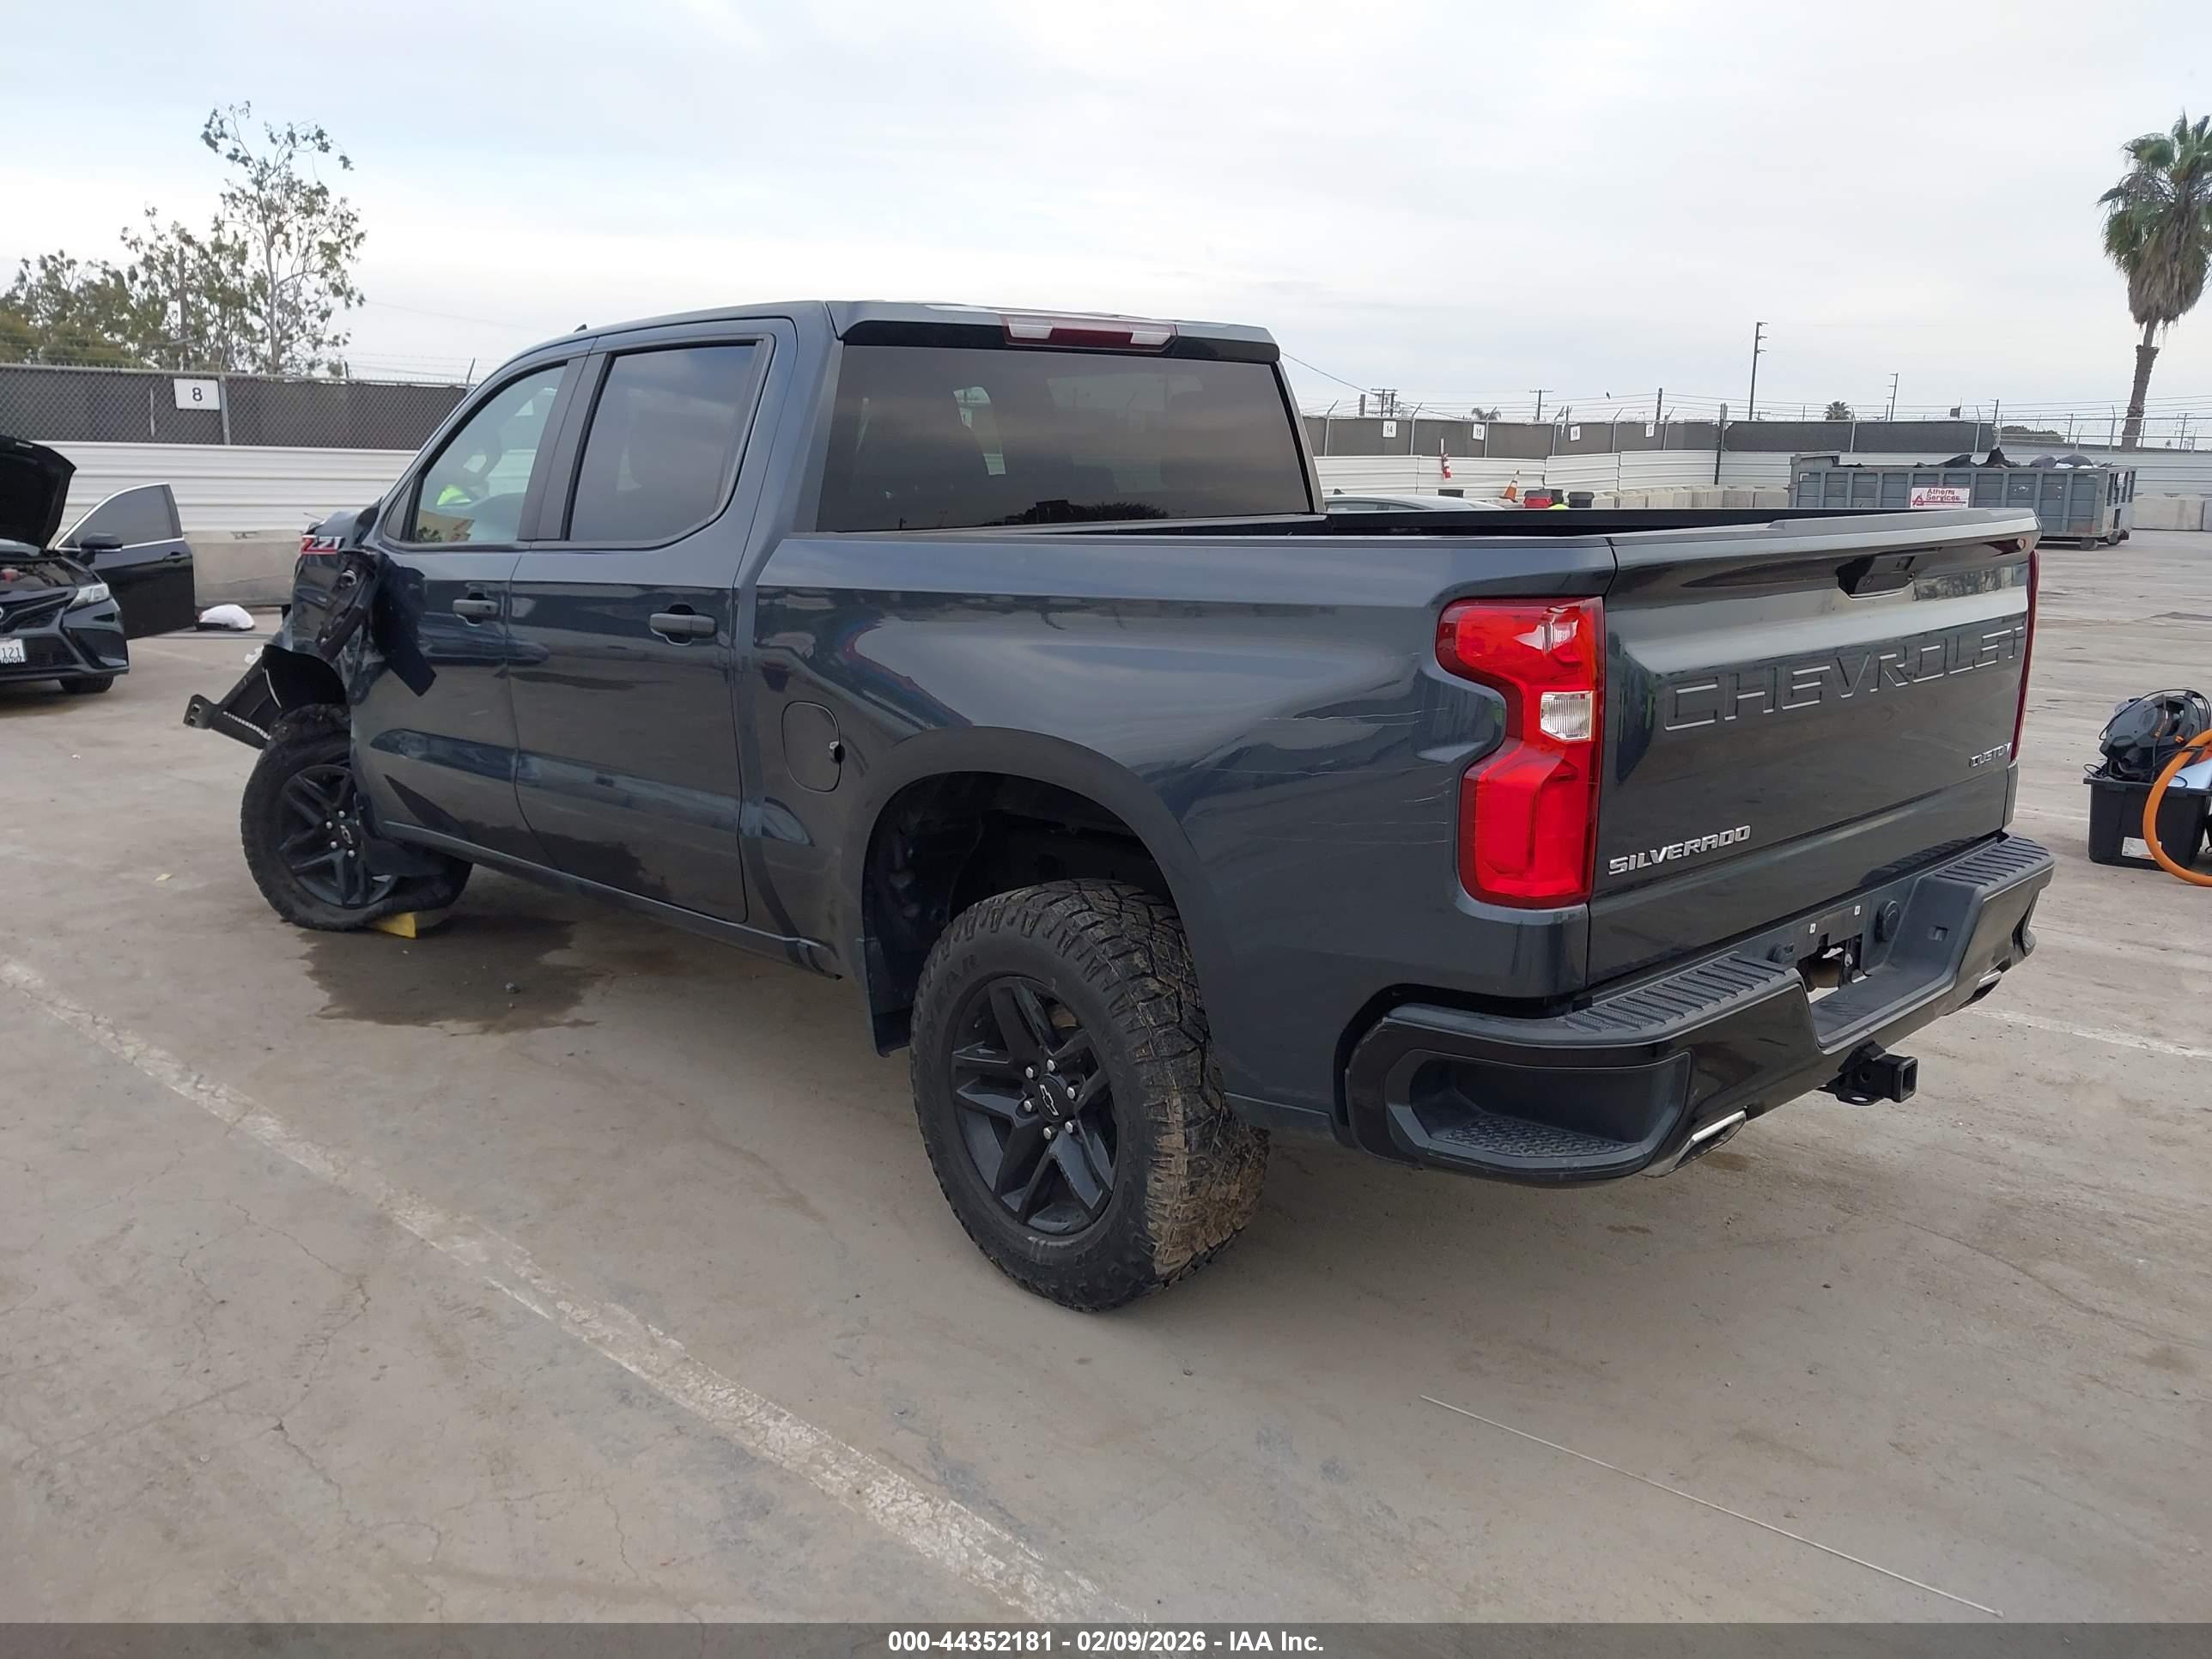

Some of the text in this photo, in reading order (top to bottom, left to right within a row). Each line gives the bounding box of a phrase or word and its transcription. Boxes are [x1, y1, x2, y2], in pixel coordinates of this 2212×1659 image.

[192, 387, 203, 402] 8
[1663, 624, 2025, 731] CHEVROLET
[1607, 824, 1751, 876] SILVERADO
